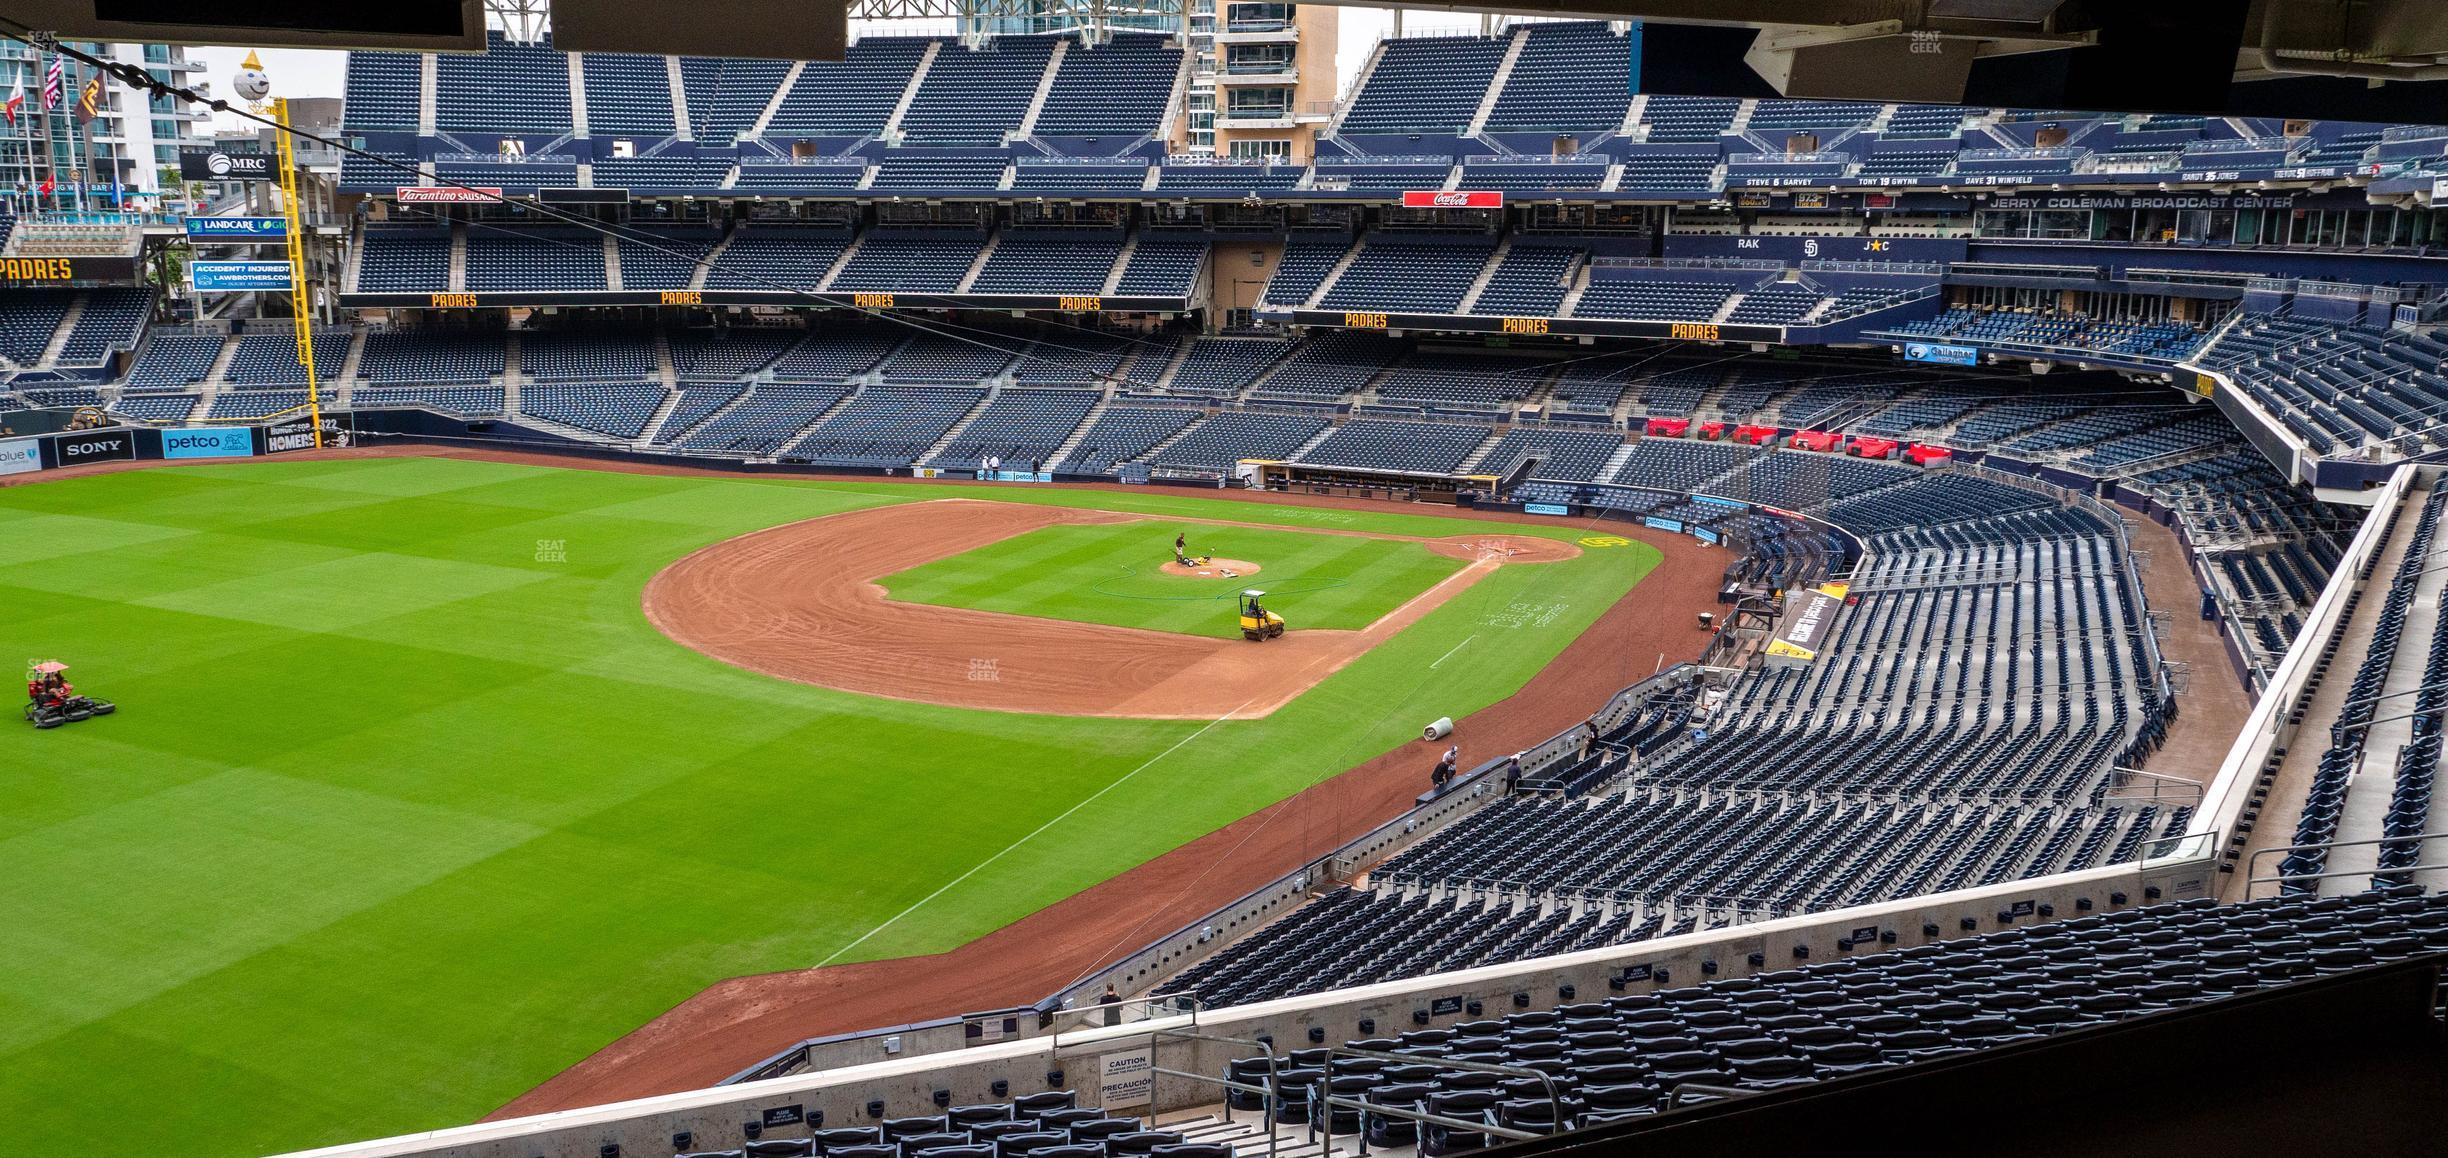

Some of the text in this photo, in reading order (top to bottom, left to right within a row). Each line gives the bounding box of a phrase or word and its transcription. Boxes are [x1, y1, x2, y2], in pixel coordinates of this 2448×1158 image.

[232, 158, 266, 169] MRC
[1747, 178, 1770, 186] STEVE
[1783, 178, 1813, 186] GARVEY
[1880, 177, 1890, 186] 19
[1965, 176, 2033, 185] DAVE 31 WINFIELD
[2205, 171, 2216, 181] 35
[400, 189, 457, 201] Tarantino
[1990, 197, 2294, 209] JERRY COLEMAN BROADCAST CENTER
[204, 220, 256, 230] LANDCARE
[1738, 239, 1760, 249] RAK
[196, 265, 290, 273] ACCIDENT? INJURED?
[431, 293, 478, 308] PADRES
[661, 291, 702, 305] PADRES
[854, 293, 894, 309] PADRES
[1060, 296, 1101, 311] PADRES
[1345, 312, 1387, 329] PADRES
[1503, 317, 1548, 336] PADRES
[1672, 323, 1719, 341] PADRES
[67, 440, 123, 456] SONY
[168, 434, 220, 452] petco
[269, 432, 315, 452] HOMERS
[1015, 472, 1033, 481] petco
[1526, 504, 1546, 513] petco
[1110, 1056, 1146, 1068] CAUTION
